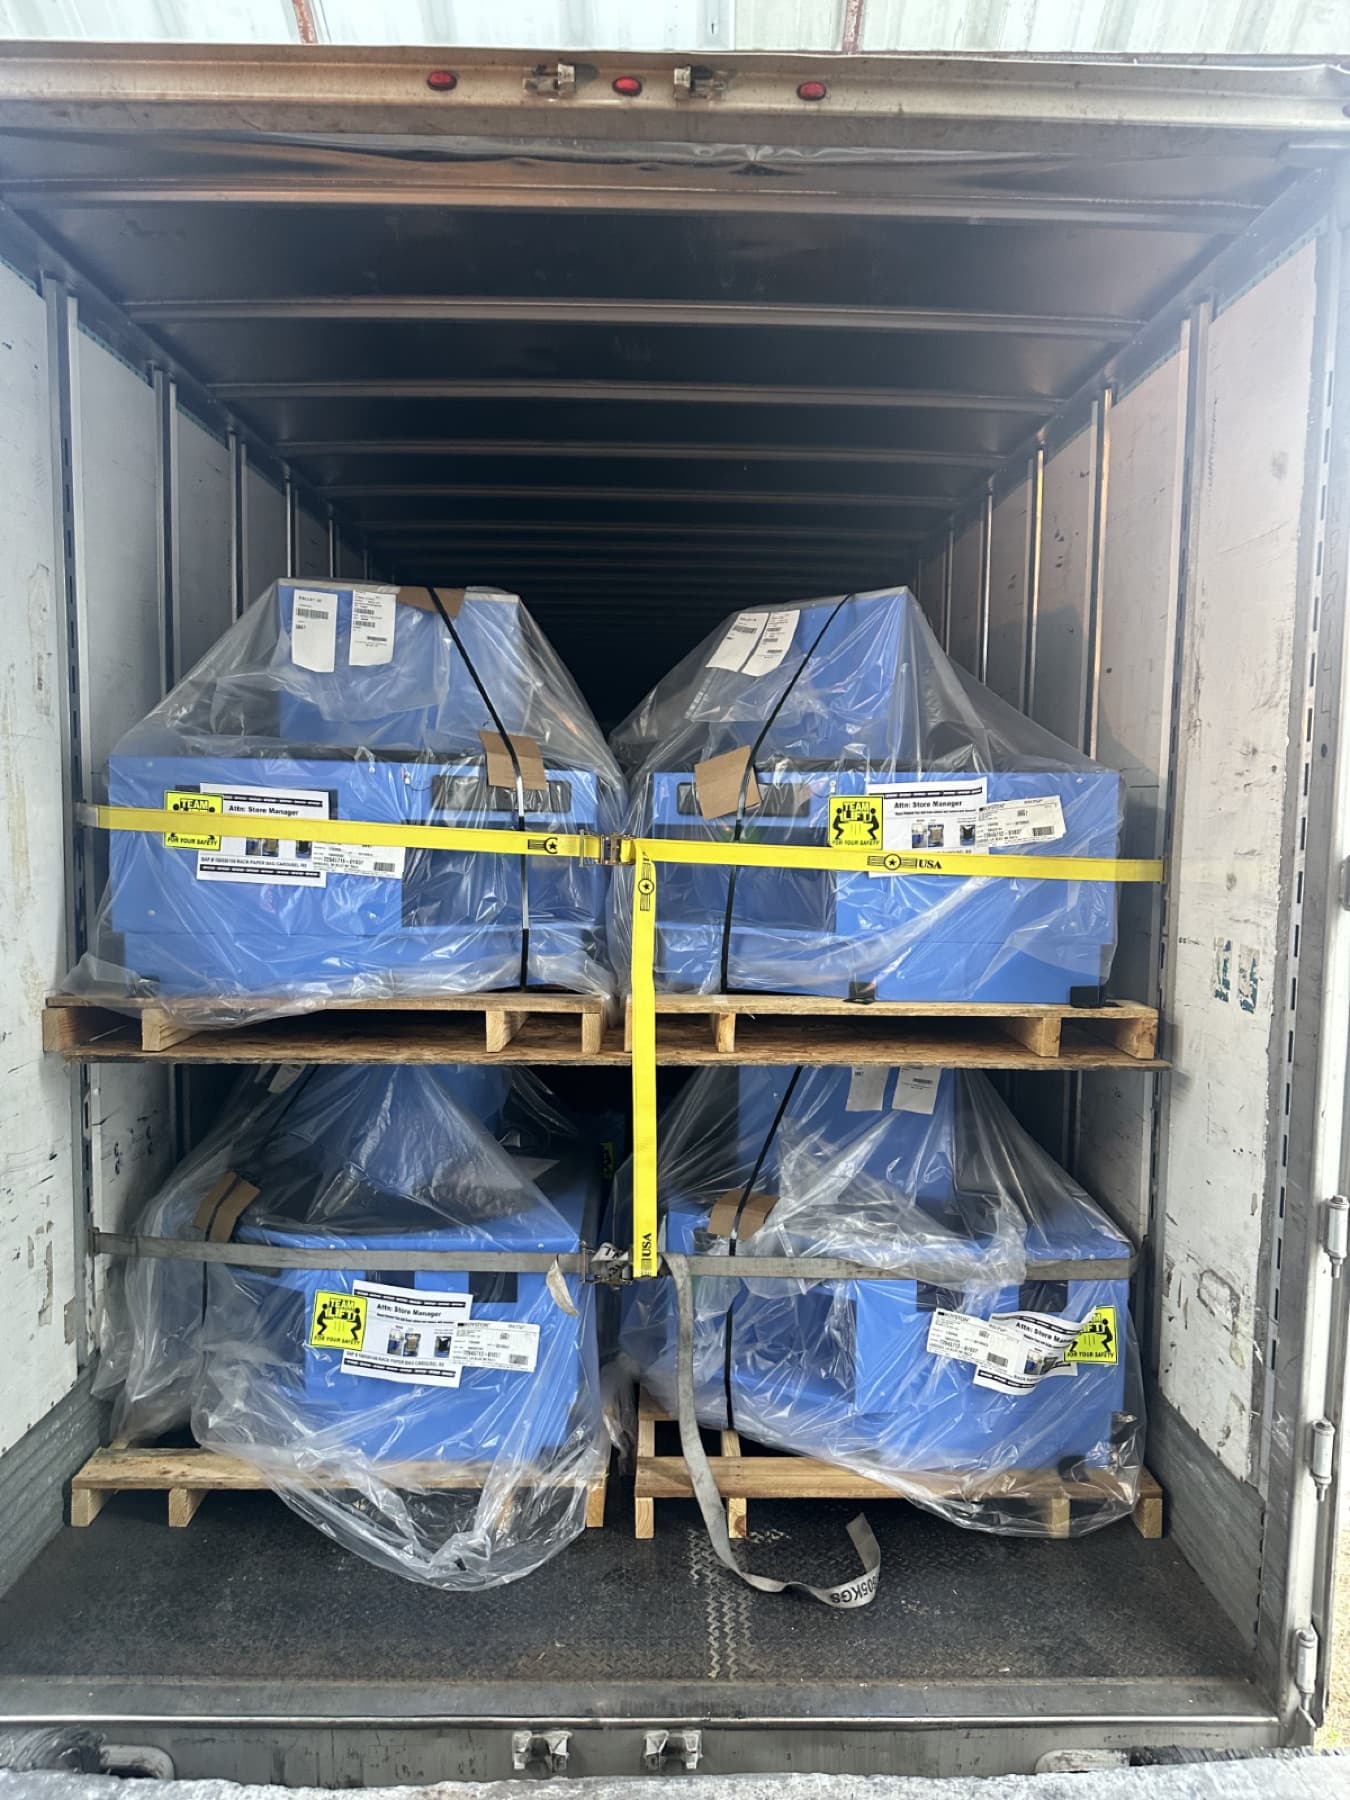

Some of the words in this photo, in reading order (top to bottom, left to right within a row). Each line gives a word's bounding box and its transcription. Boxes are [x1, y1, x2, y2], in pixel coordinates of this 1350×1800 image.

[180, 798, 209, 811] TEAM
[843, 801, 870, 812] TEAM
[894, 801, 911, 809] Attn:
[932, 800, 962, 809] Manager
[269, 807, 299, 817] Manager
[197, 838, 218, 846] SAFETY
[919, 858, 943, 870] USA
[641, 1232, 652, 1257] USA
[329, 1297, 356, 1310] TEAM
[377, 1303, 393, 1311] Attn:
[394, 1306, 411, 1315] Store
[412, 1308, 442, 1318] Manager
[1015, 1322, 1033, 1333] Attn:
[1034, 1328, 1053, 1340] Store
